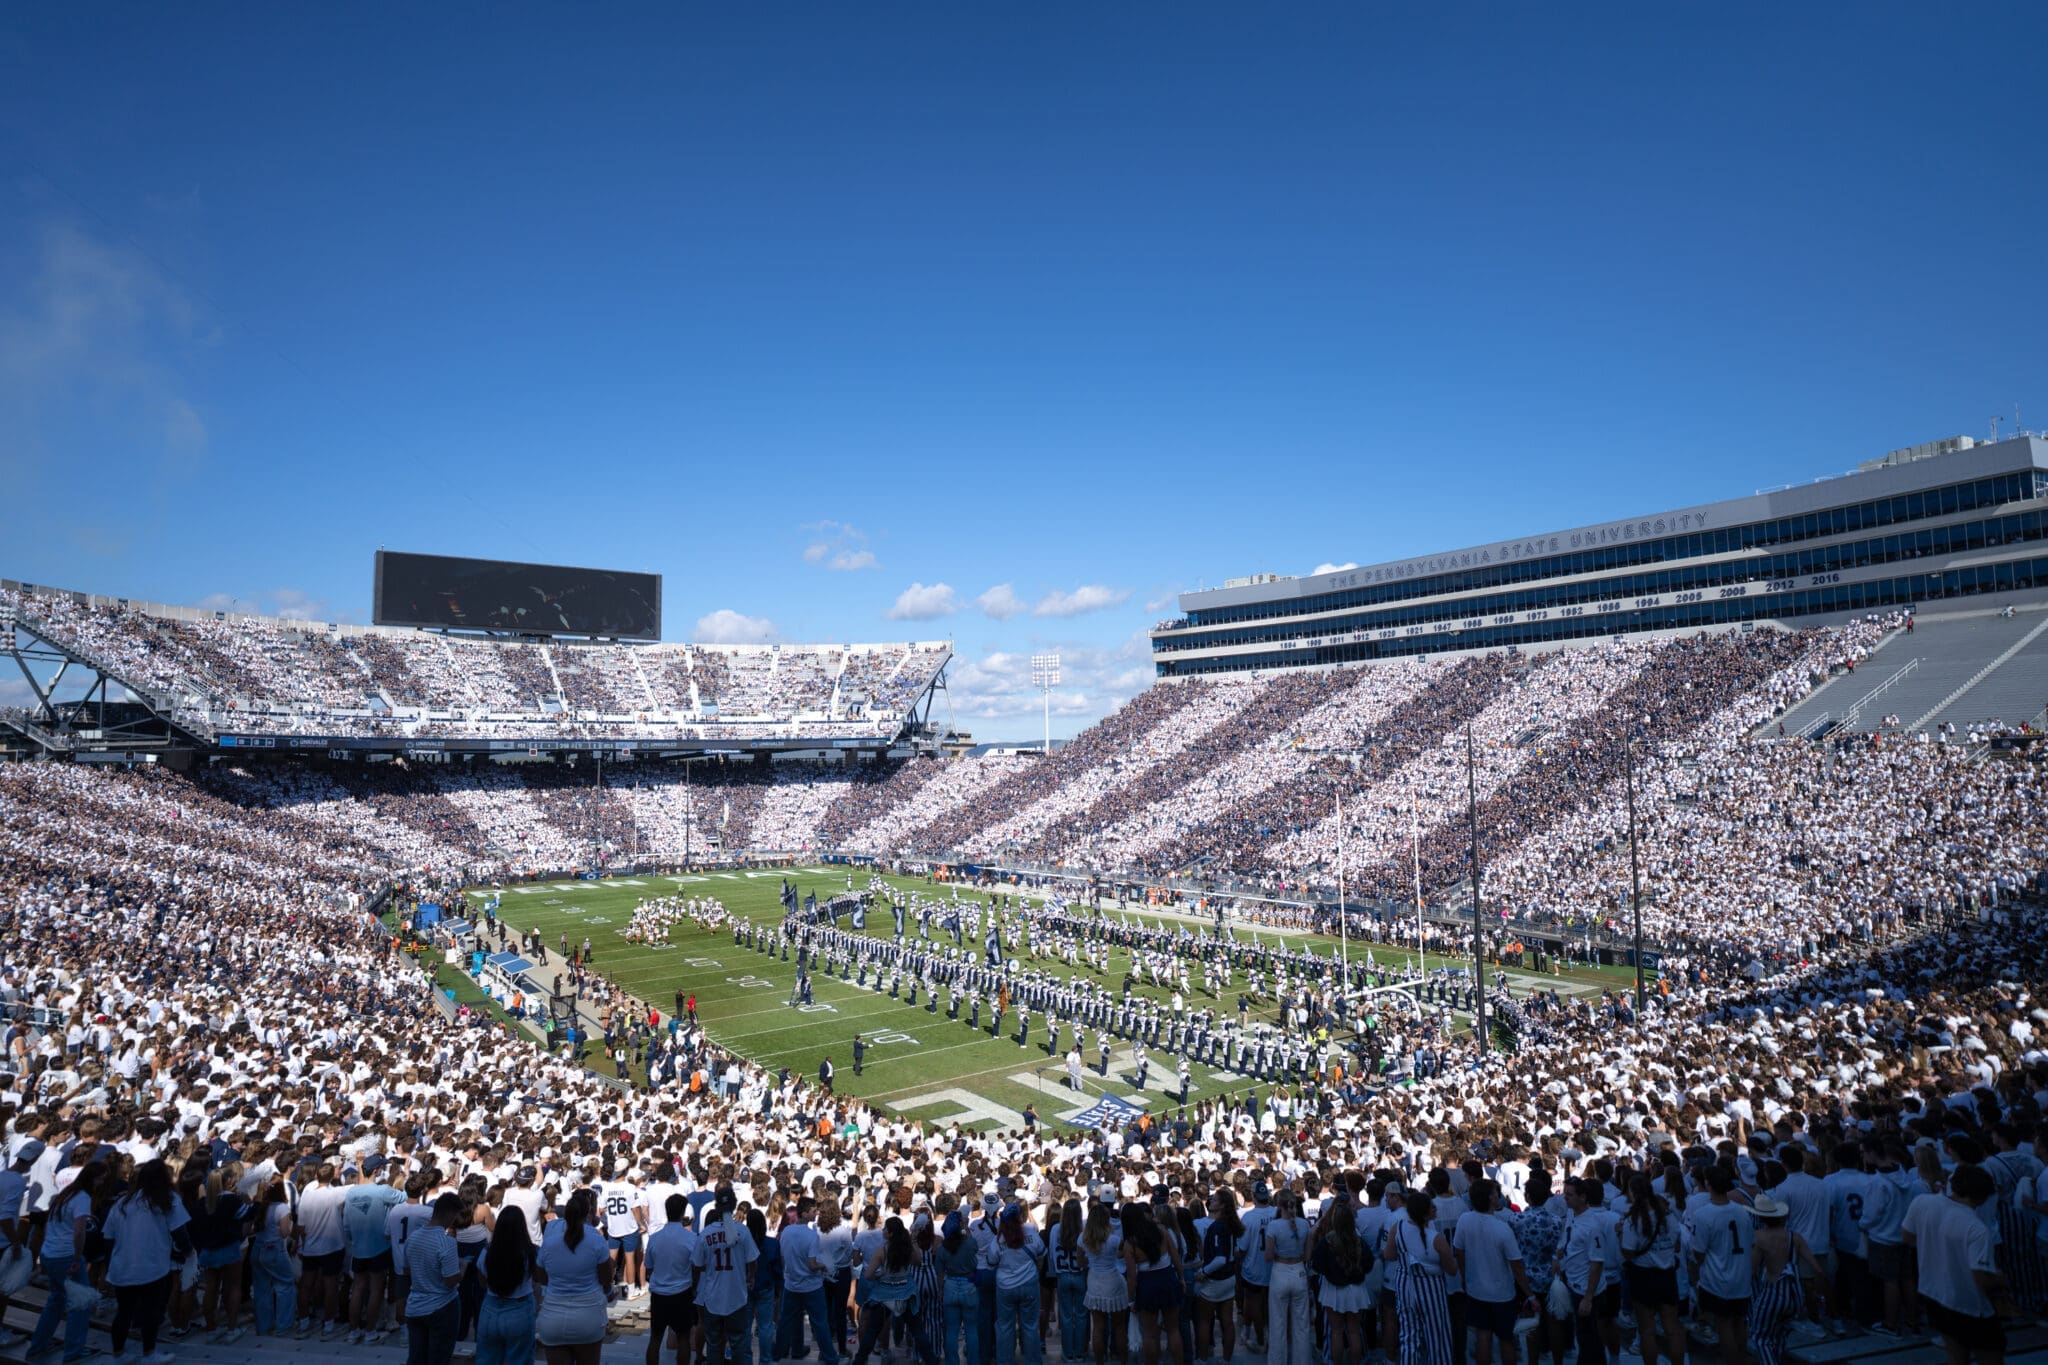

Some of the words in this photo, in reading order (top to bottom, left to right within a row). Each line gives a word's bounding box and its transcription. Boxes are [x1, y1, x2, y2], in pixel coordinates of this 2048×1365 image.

[1329, 573, 1357, 589] THE
[1365, 550, 1491, 584] PENNSYLVANIA
[1499, 537, 1560, 560] STATE
[1570, 511, 1709, 547] UNIVERSITY
[1433, 623, 1451, 632] 1947
[1526, 611, 1548, 621] 1973
[1635, 597, 1660, 608] 1994
[1676, 592, 1702, 603] 2005
[1765, 580, 1795, 593] 2012
[1812, 573, 1840, 585] 2016
[469, 880, 649, 898] PENN
[664, 868, 845, 883] STATE
[859, 1028, 912, 1044] 10
[1514, 1171, 1521, 1190] 1
[607, 1197, 628, 1215] 26
[1846, 1193, 1864, 1220] 2
[399, 1216, 409, 1244] 1
[1594, 1236, 1601, 1249] 1
[1728, 1220, 1745, 1255] 1
[714, 1248, 733, 1271] 11
